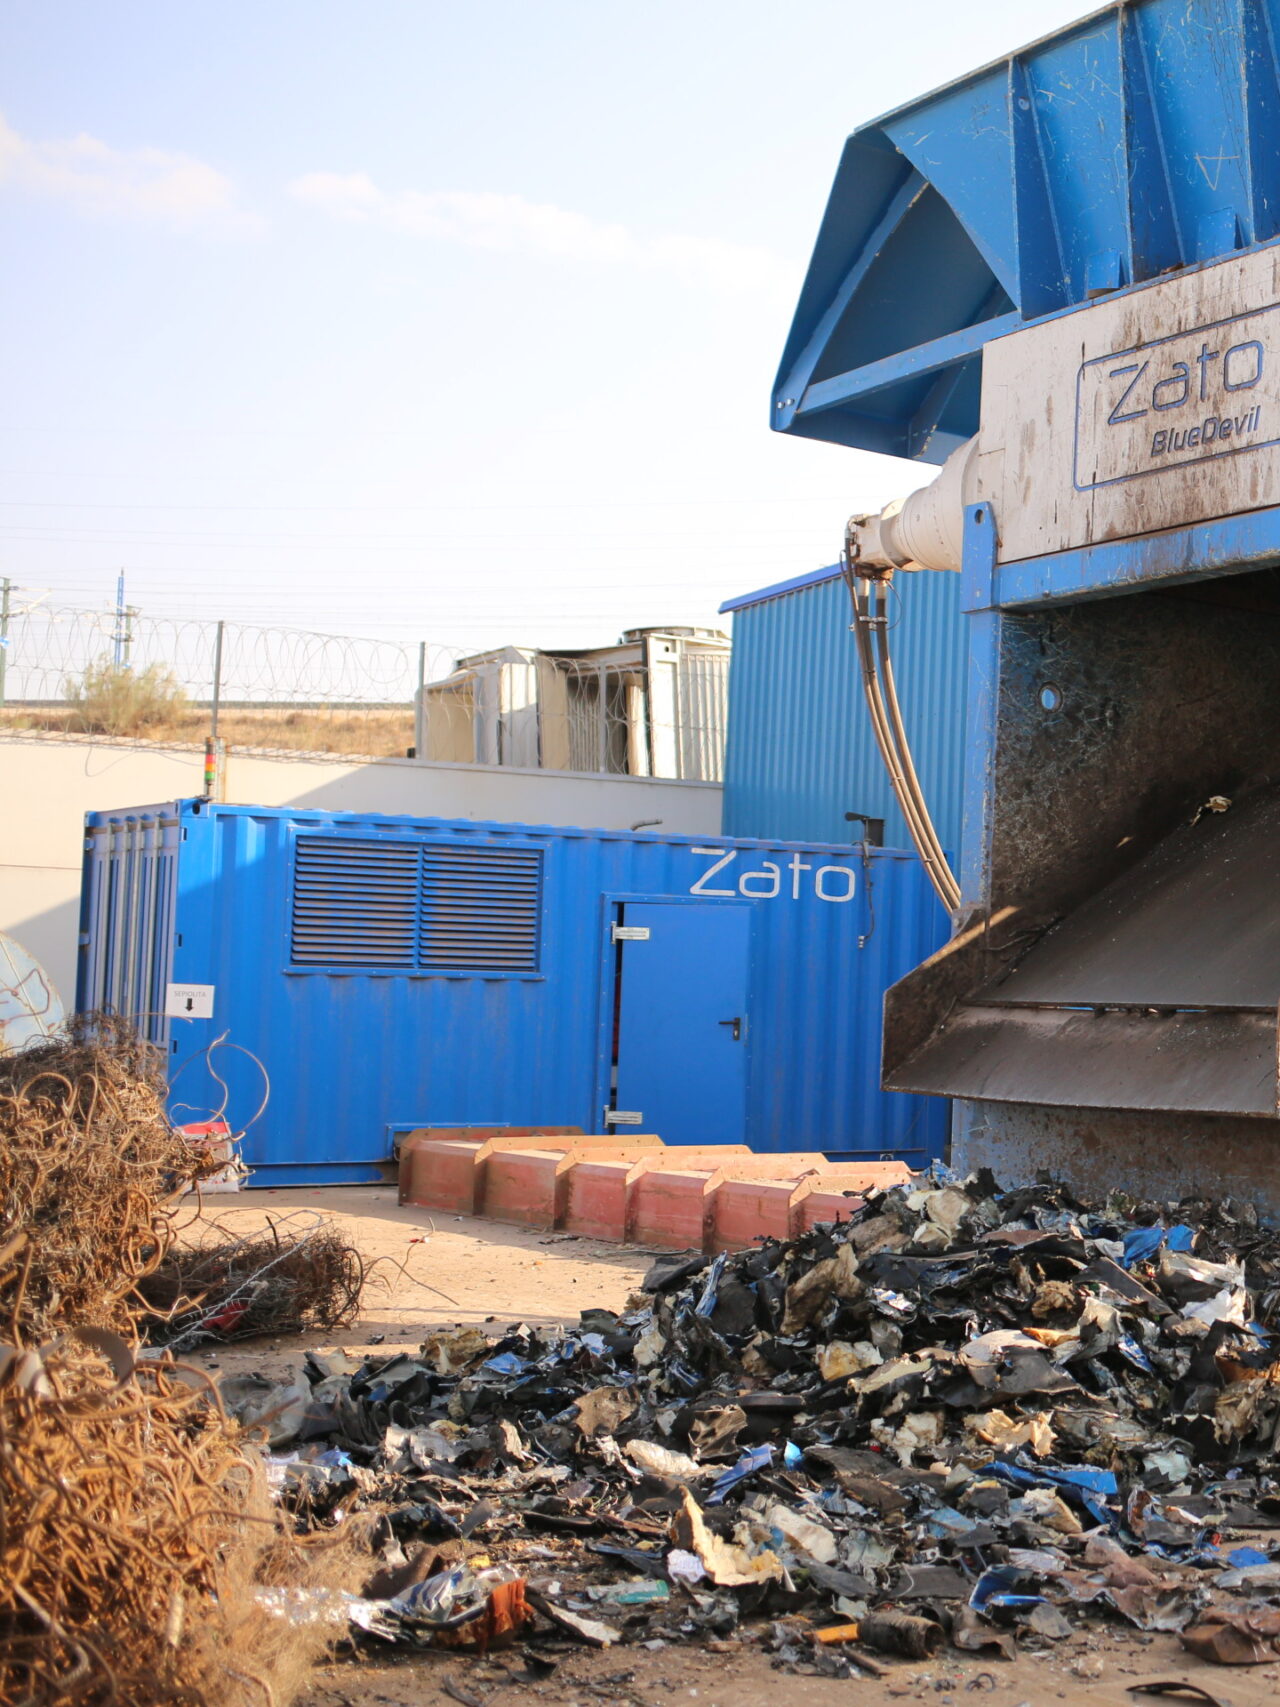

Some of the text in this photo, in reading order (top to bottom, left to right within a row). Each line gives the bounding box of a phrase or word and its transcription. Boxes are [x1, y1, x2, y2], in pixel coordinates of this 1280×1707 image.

[1108, 340, 1263, 425] Zato
[1151, 405, 1261, 457] BlueDevil
[690, 848, 856, 903] Zato
